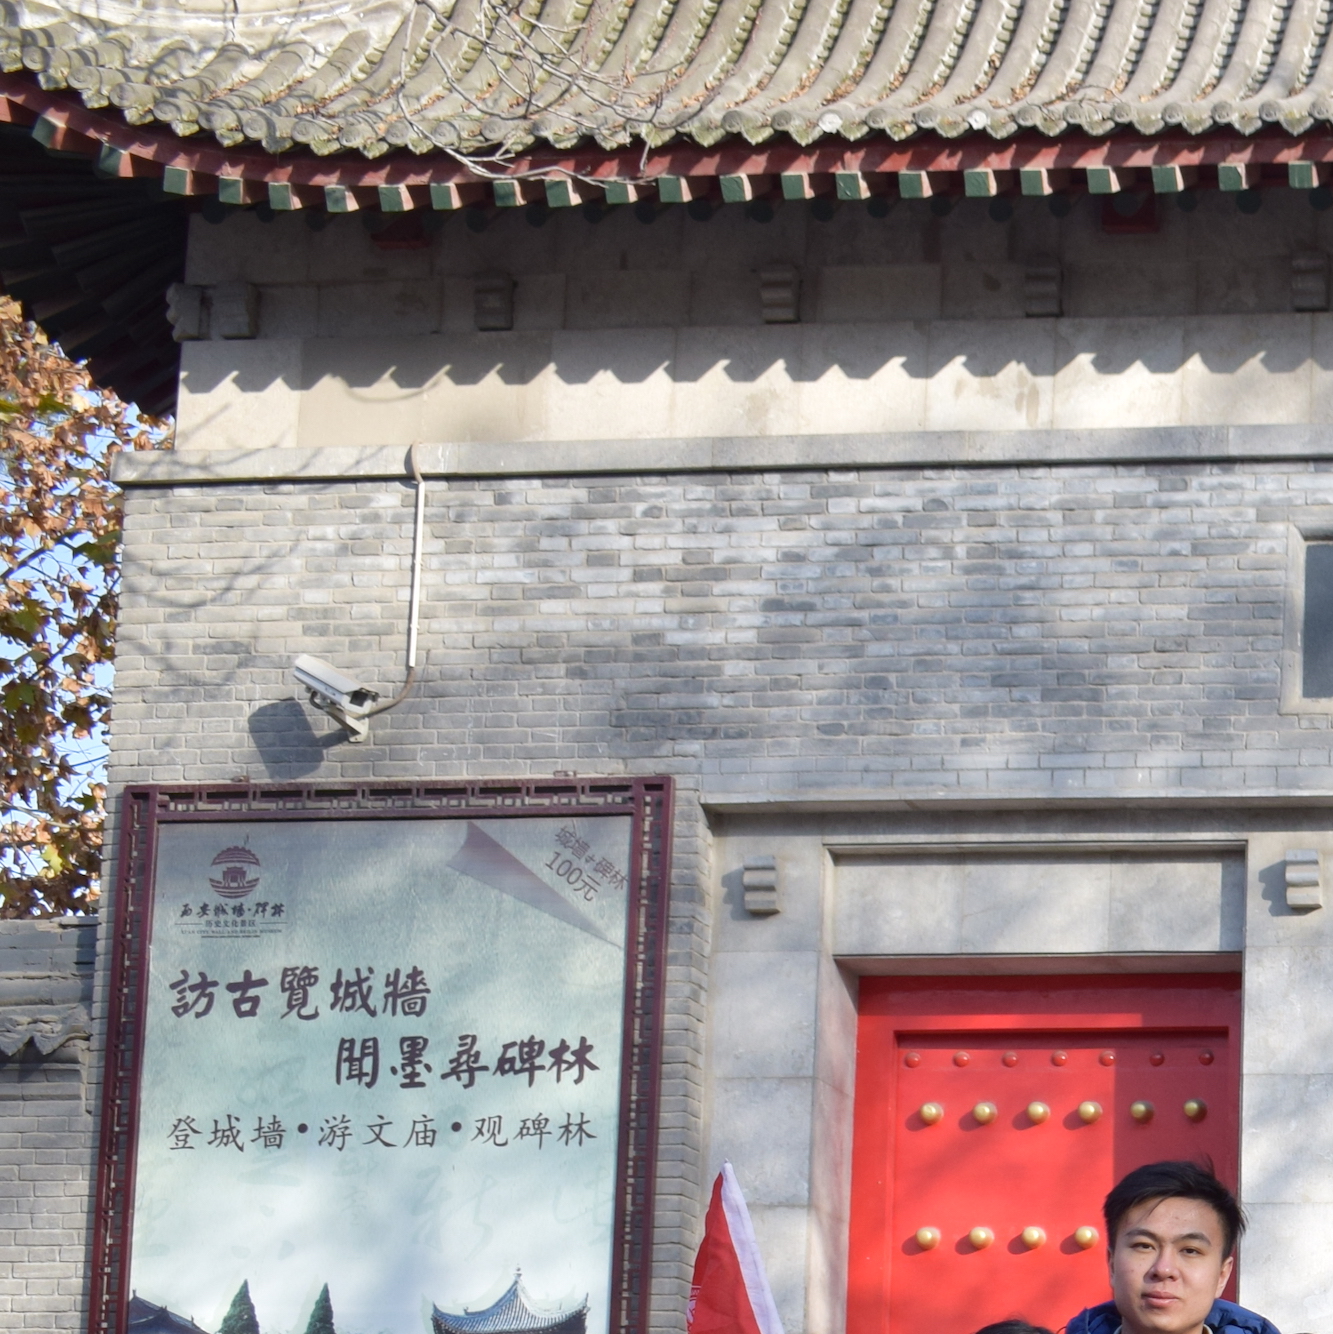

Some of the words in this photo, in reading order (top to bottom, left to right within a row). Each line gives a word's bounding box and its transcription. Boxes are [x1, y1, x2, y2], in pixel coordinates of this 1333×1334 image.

[545, 851, 601, 901] 100元
[336, 1034, 600, 1089] 聞墨尋碑林
